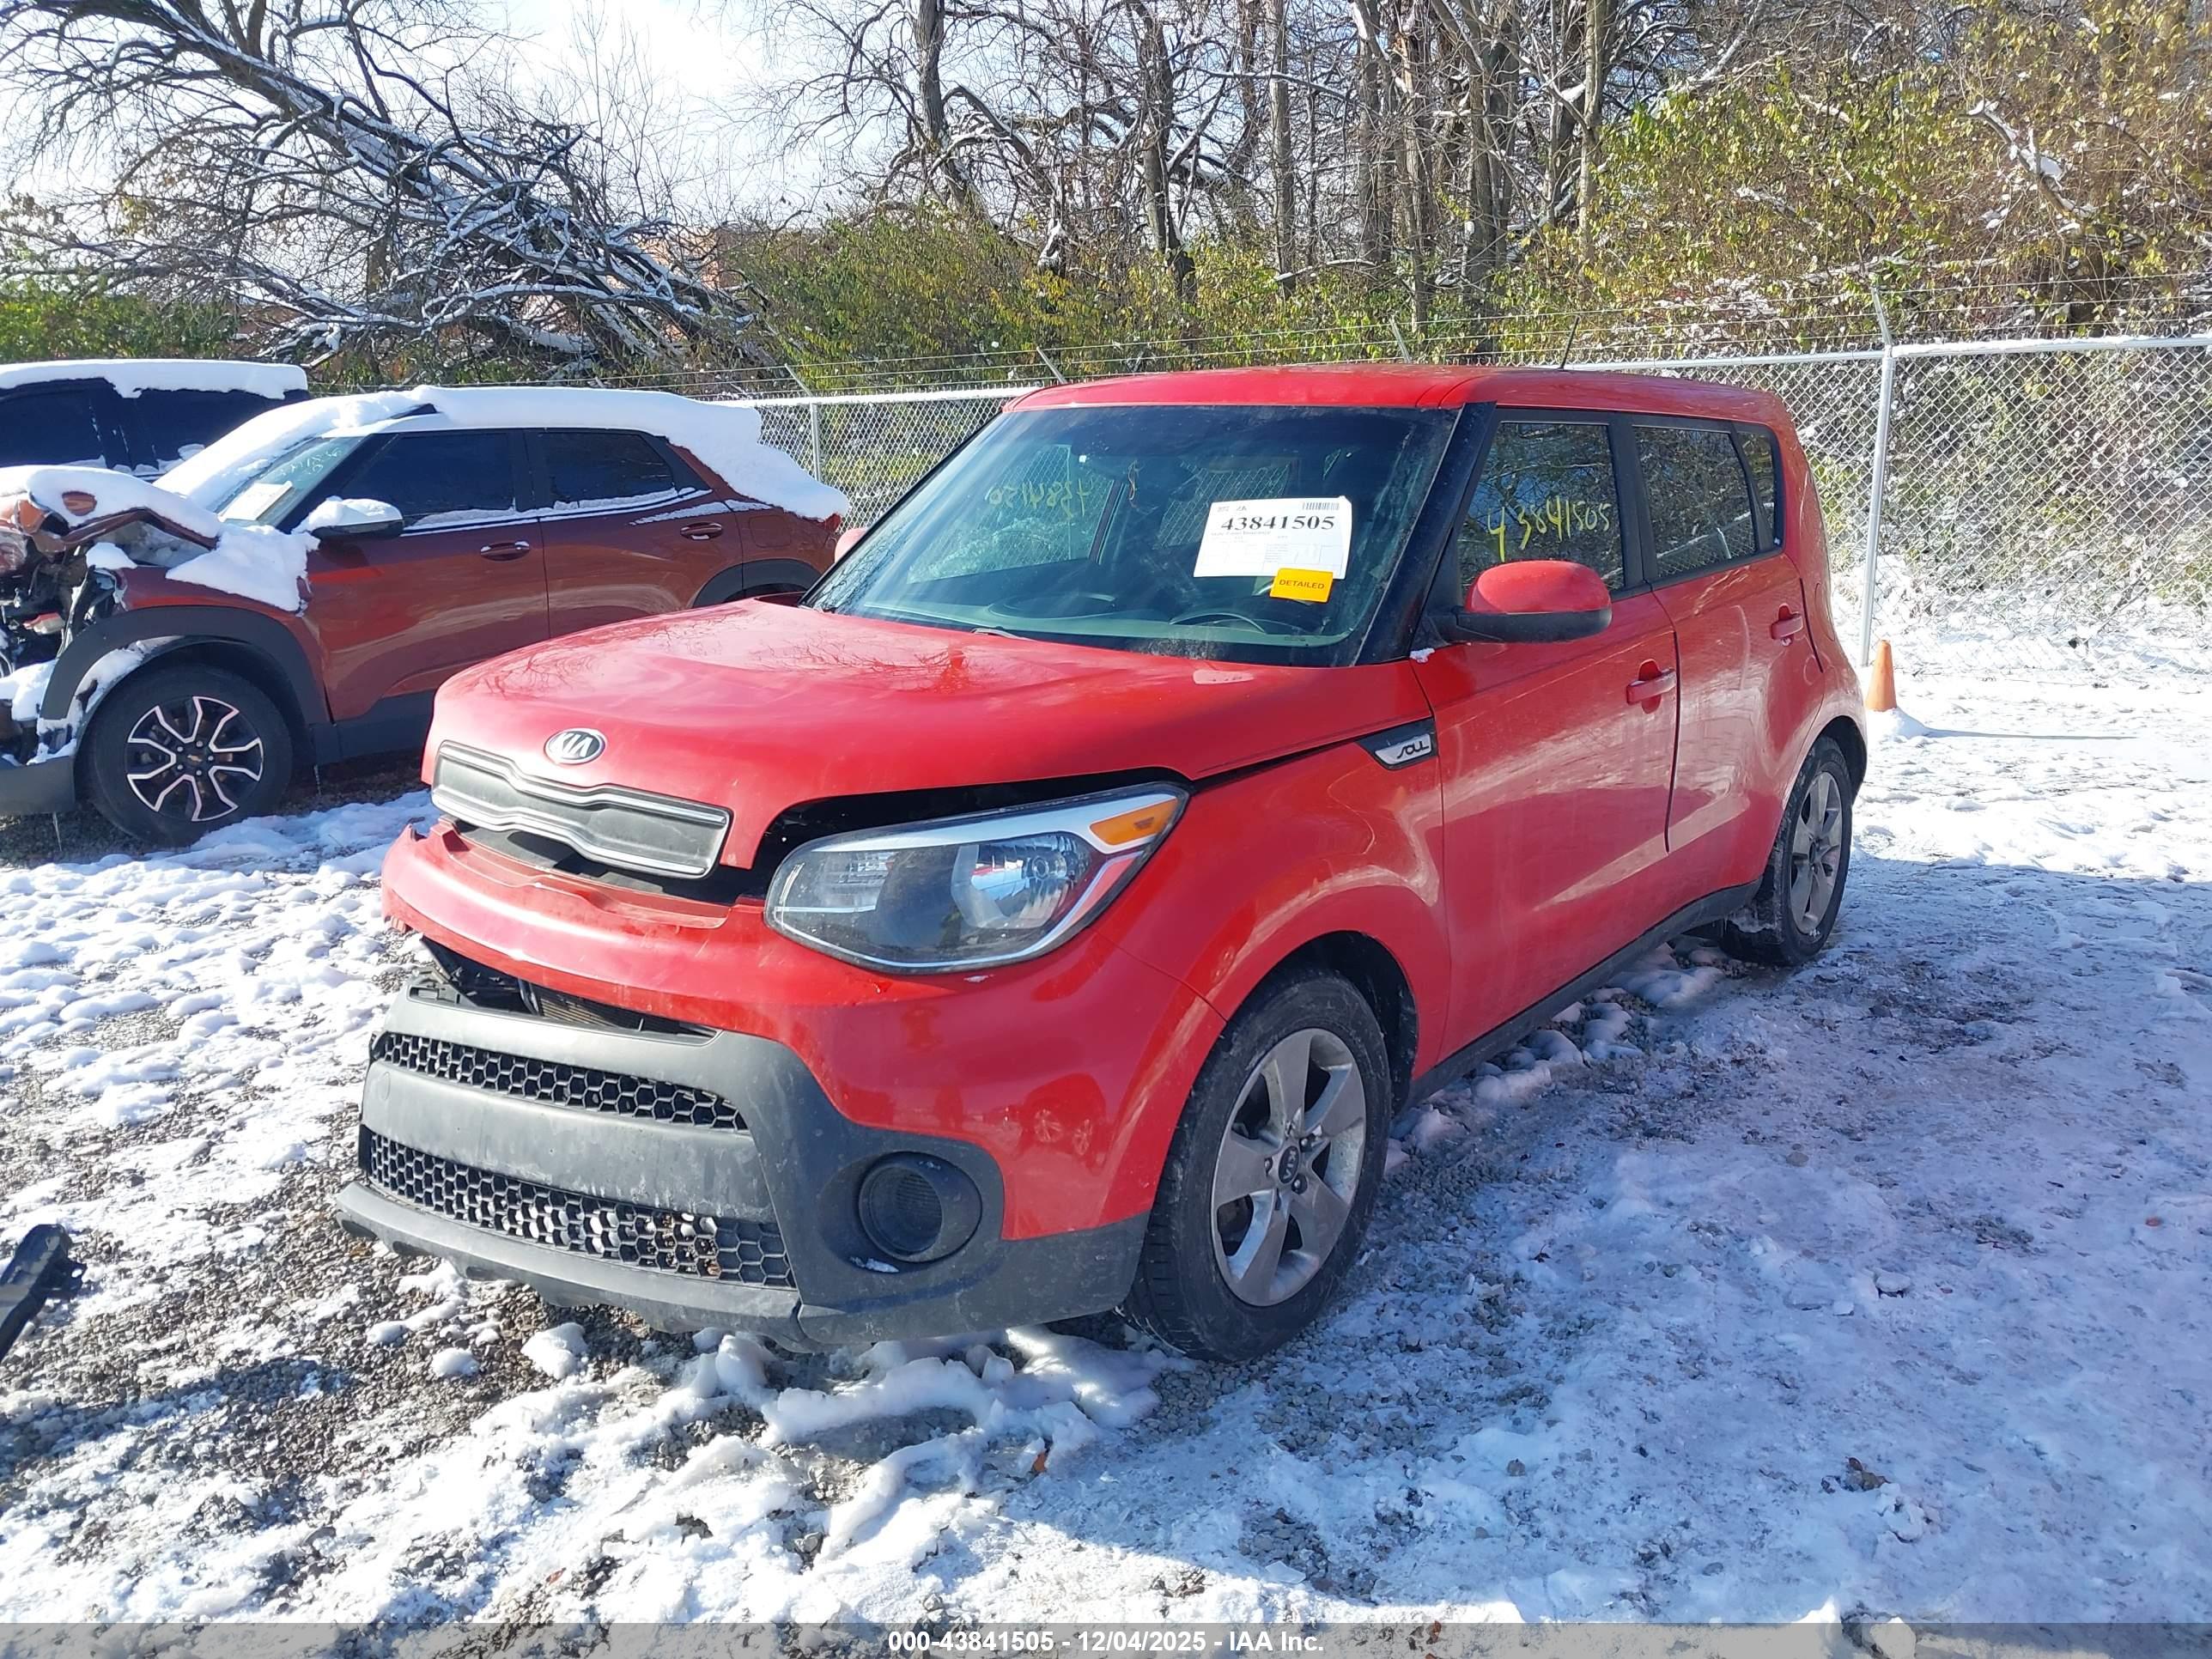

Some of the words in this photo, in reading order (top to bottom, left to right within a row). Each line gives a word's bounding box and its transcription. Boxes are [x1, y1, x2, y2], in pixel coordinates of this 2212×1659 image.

[1221, 515, 1335, 531] 43841505
[1487, 495, 1611, 562] 43841505
[1279, 579, 1325, 590] DETAILED
[1283, 1150, 1297, 1180] KIA
